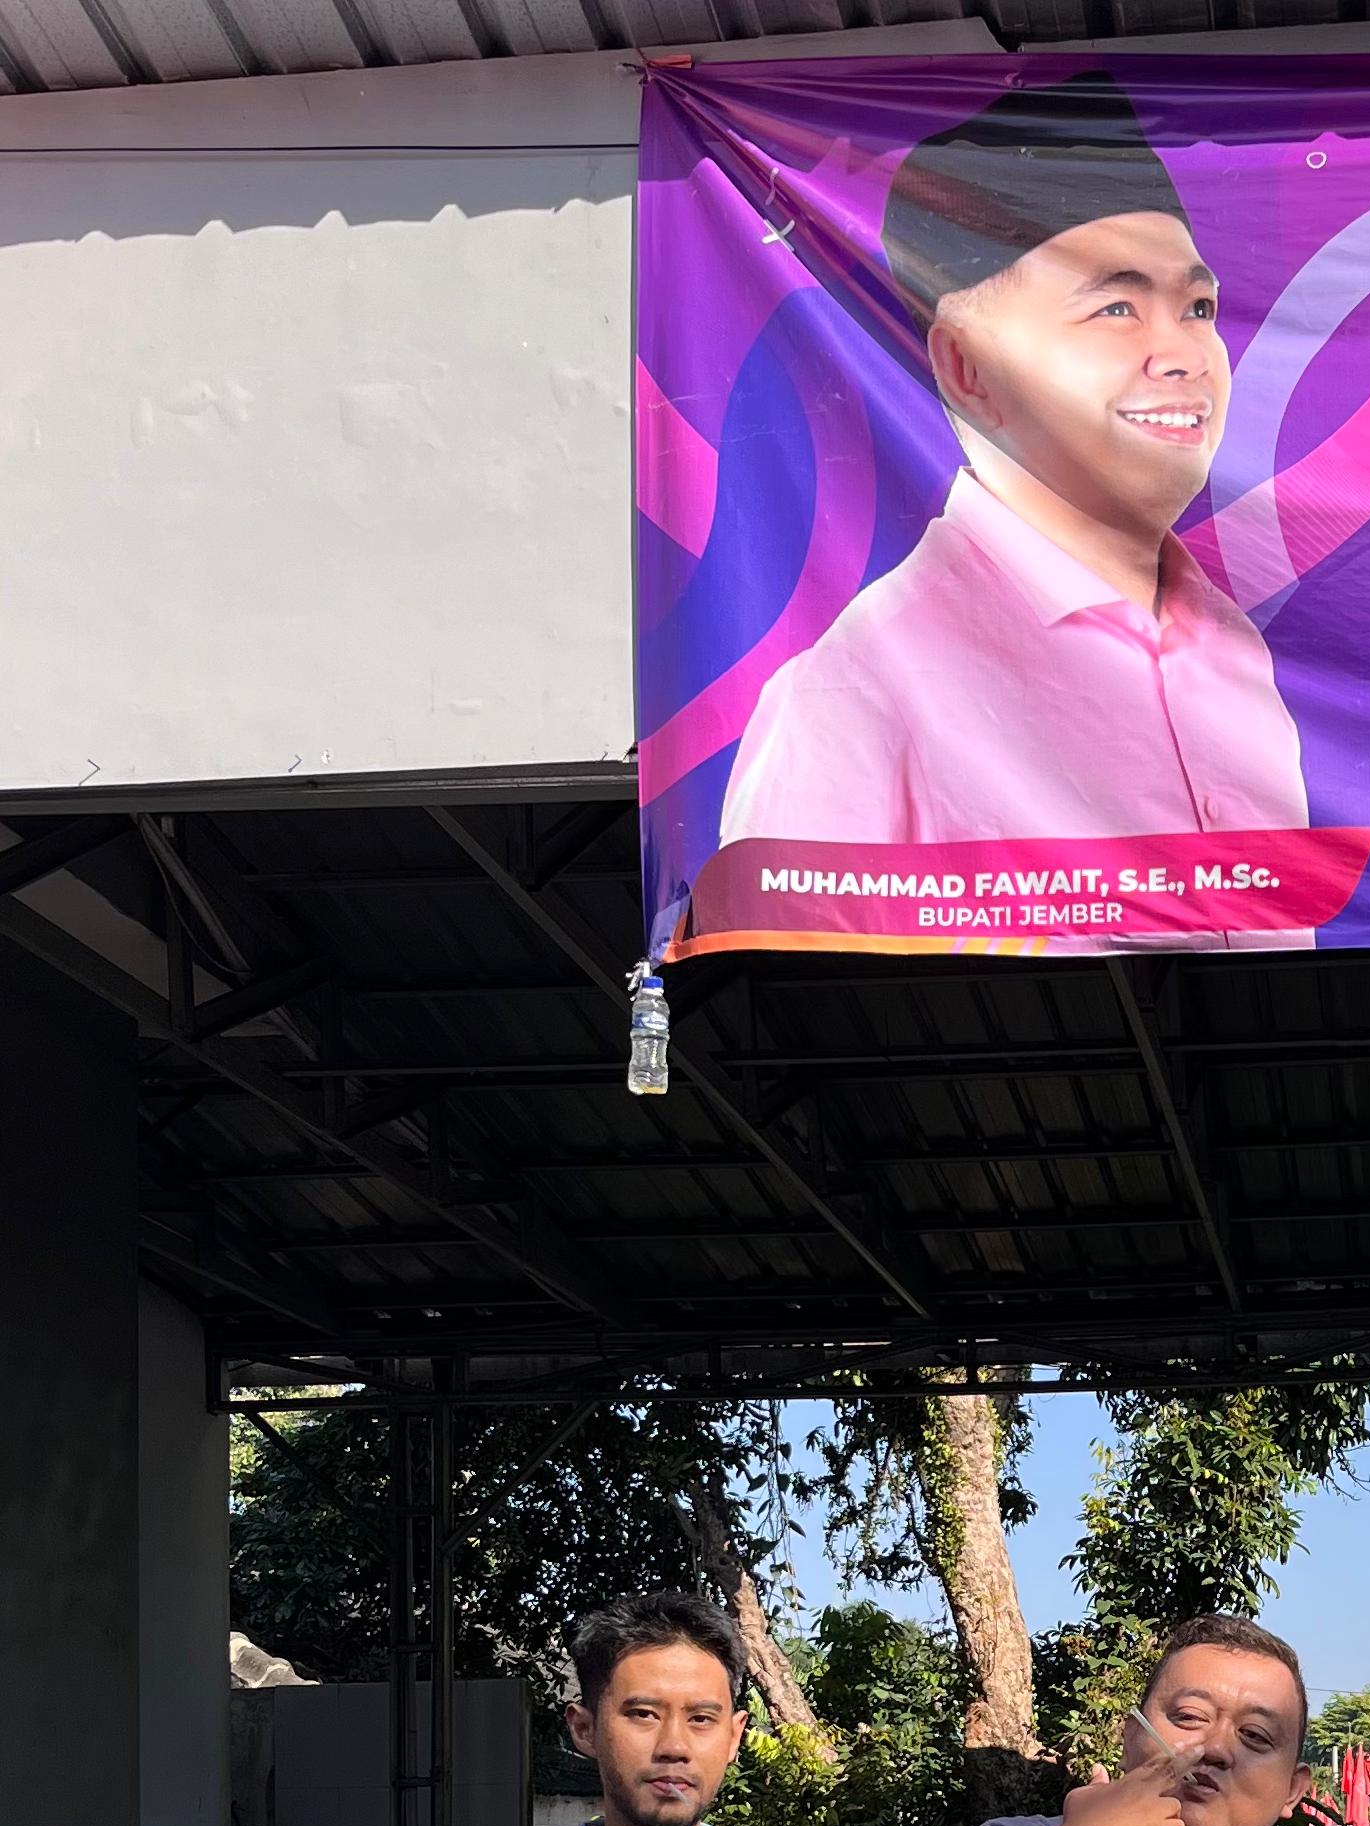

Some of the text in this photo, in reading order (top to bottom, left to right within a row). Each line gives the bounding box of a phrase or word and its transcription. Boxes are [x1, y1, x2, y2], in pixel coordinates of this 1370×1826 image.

[760, 863, 1281, 899] MUHAMMAD FAWAIT, S.E., M.Sc.
[918, 902, 1124, 928] BUPATI JEMBER
